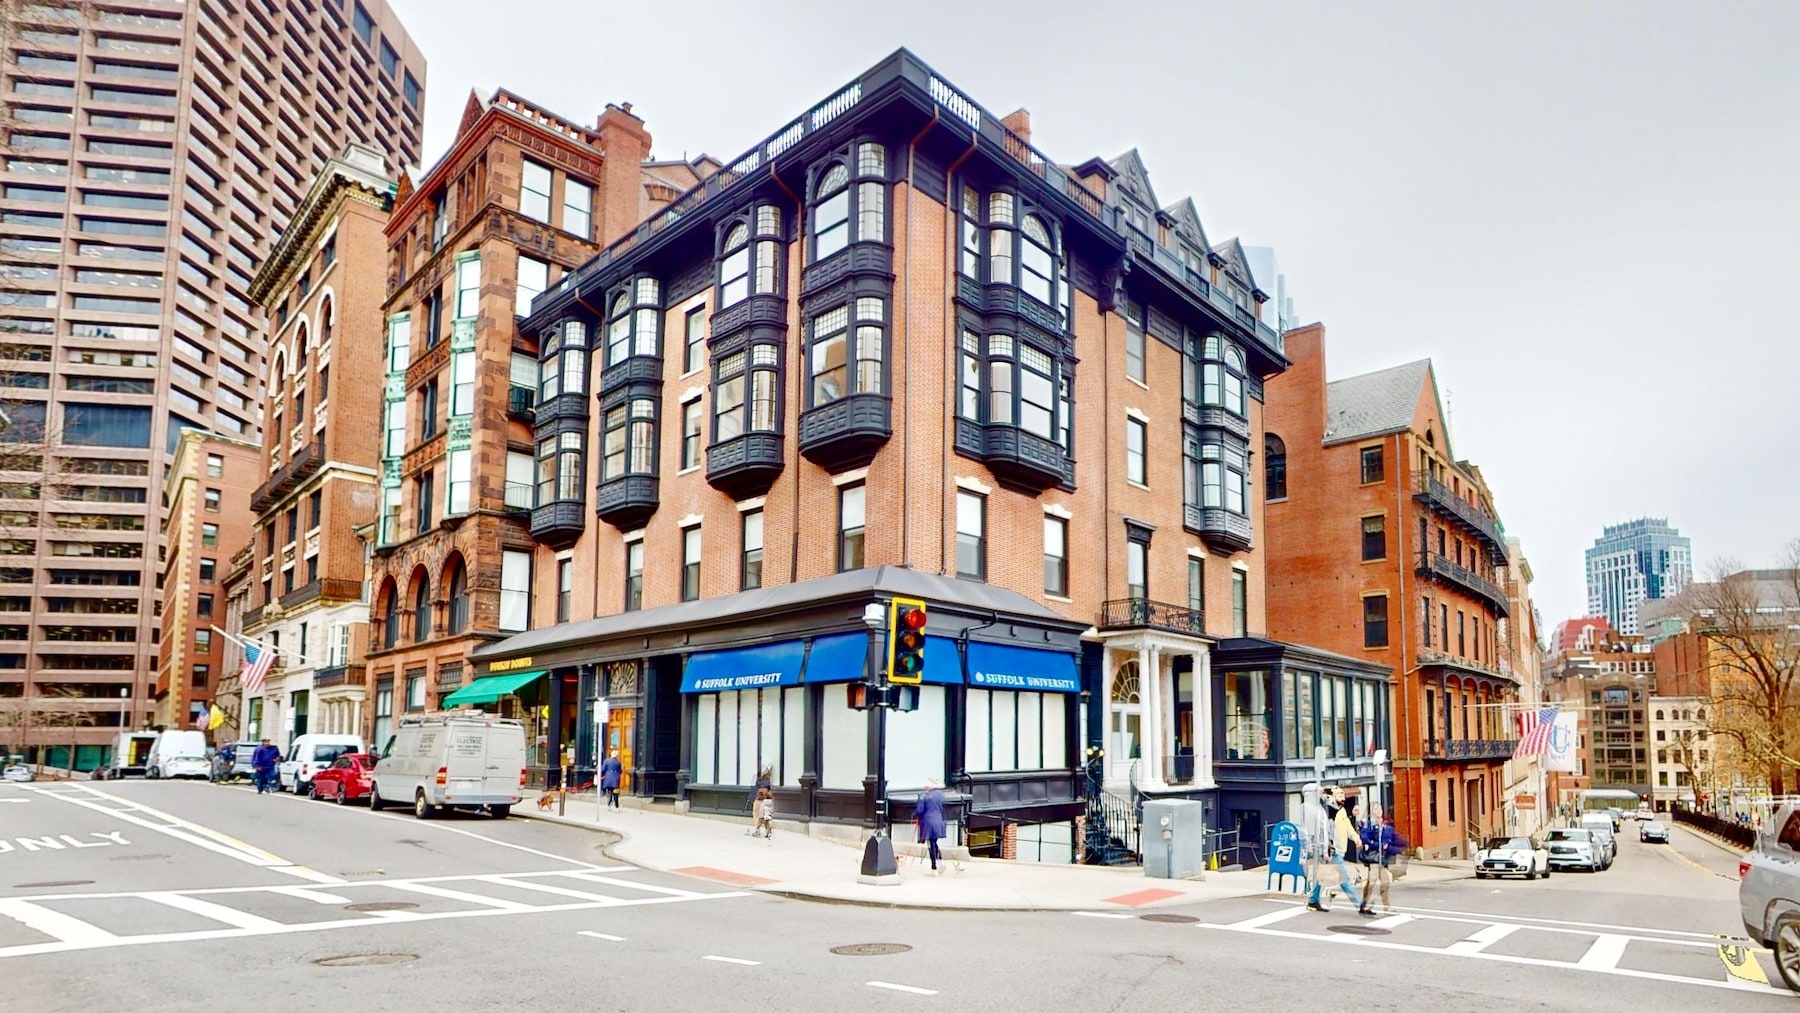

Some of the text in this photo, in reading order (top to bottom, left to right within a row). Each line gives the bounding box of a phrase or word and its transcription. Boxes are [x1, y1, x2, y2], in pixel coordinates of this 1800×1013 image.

[702, 673, 782, 689] SUFFOLK UNIVERSITY
[986, 673, 1075, 689] SUFFOLK UNIVERSITY
